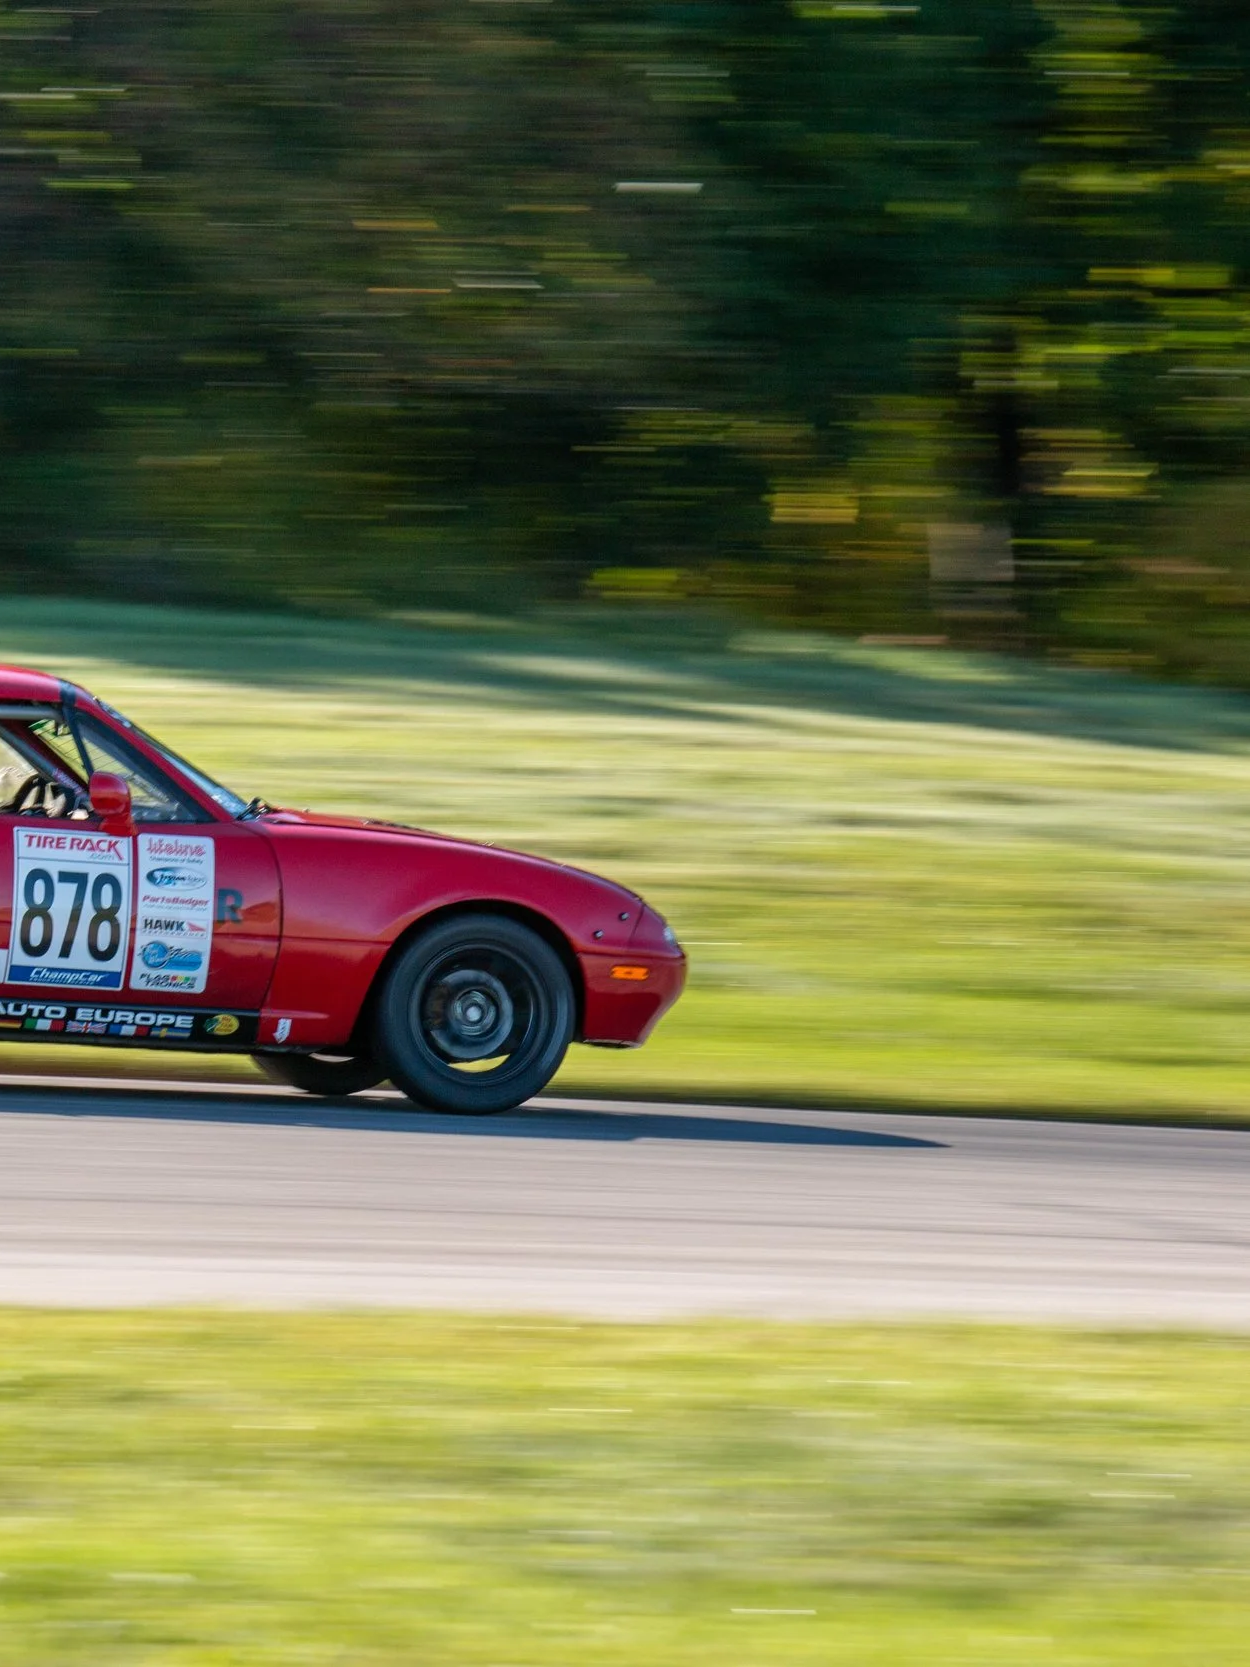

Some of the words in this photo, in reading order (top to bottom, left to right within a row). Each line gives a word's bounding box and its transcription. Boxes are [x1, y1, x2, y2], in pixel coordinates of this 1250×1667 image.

[24, 834, 67, 850] TIRE
[69, 838, 124, 861] RACK
[19, 867, 123, 963] 878
[217, 888, 244, 923] R
[144, 918, 186, 932] HAWK
[30, 967, 106, 983] ChampCar
[75, 1006, 195, 1028] EUROPE
